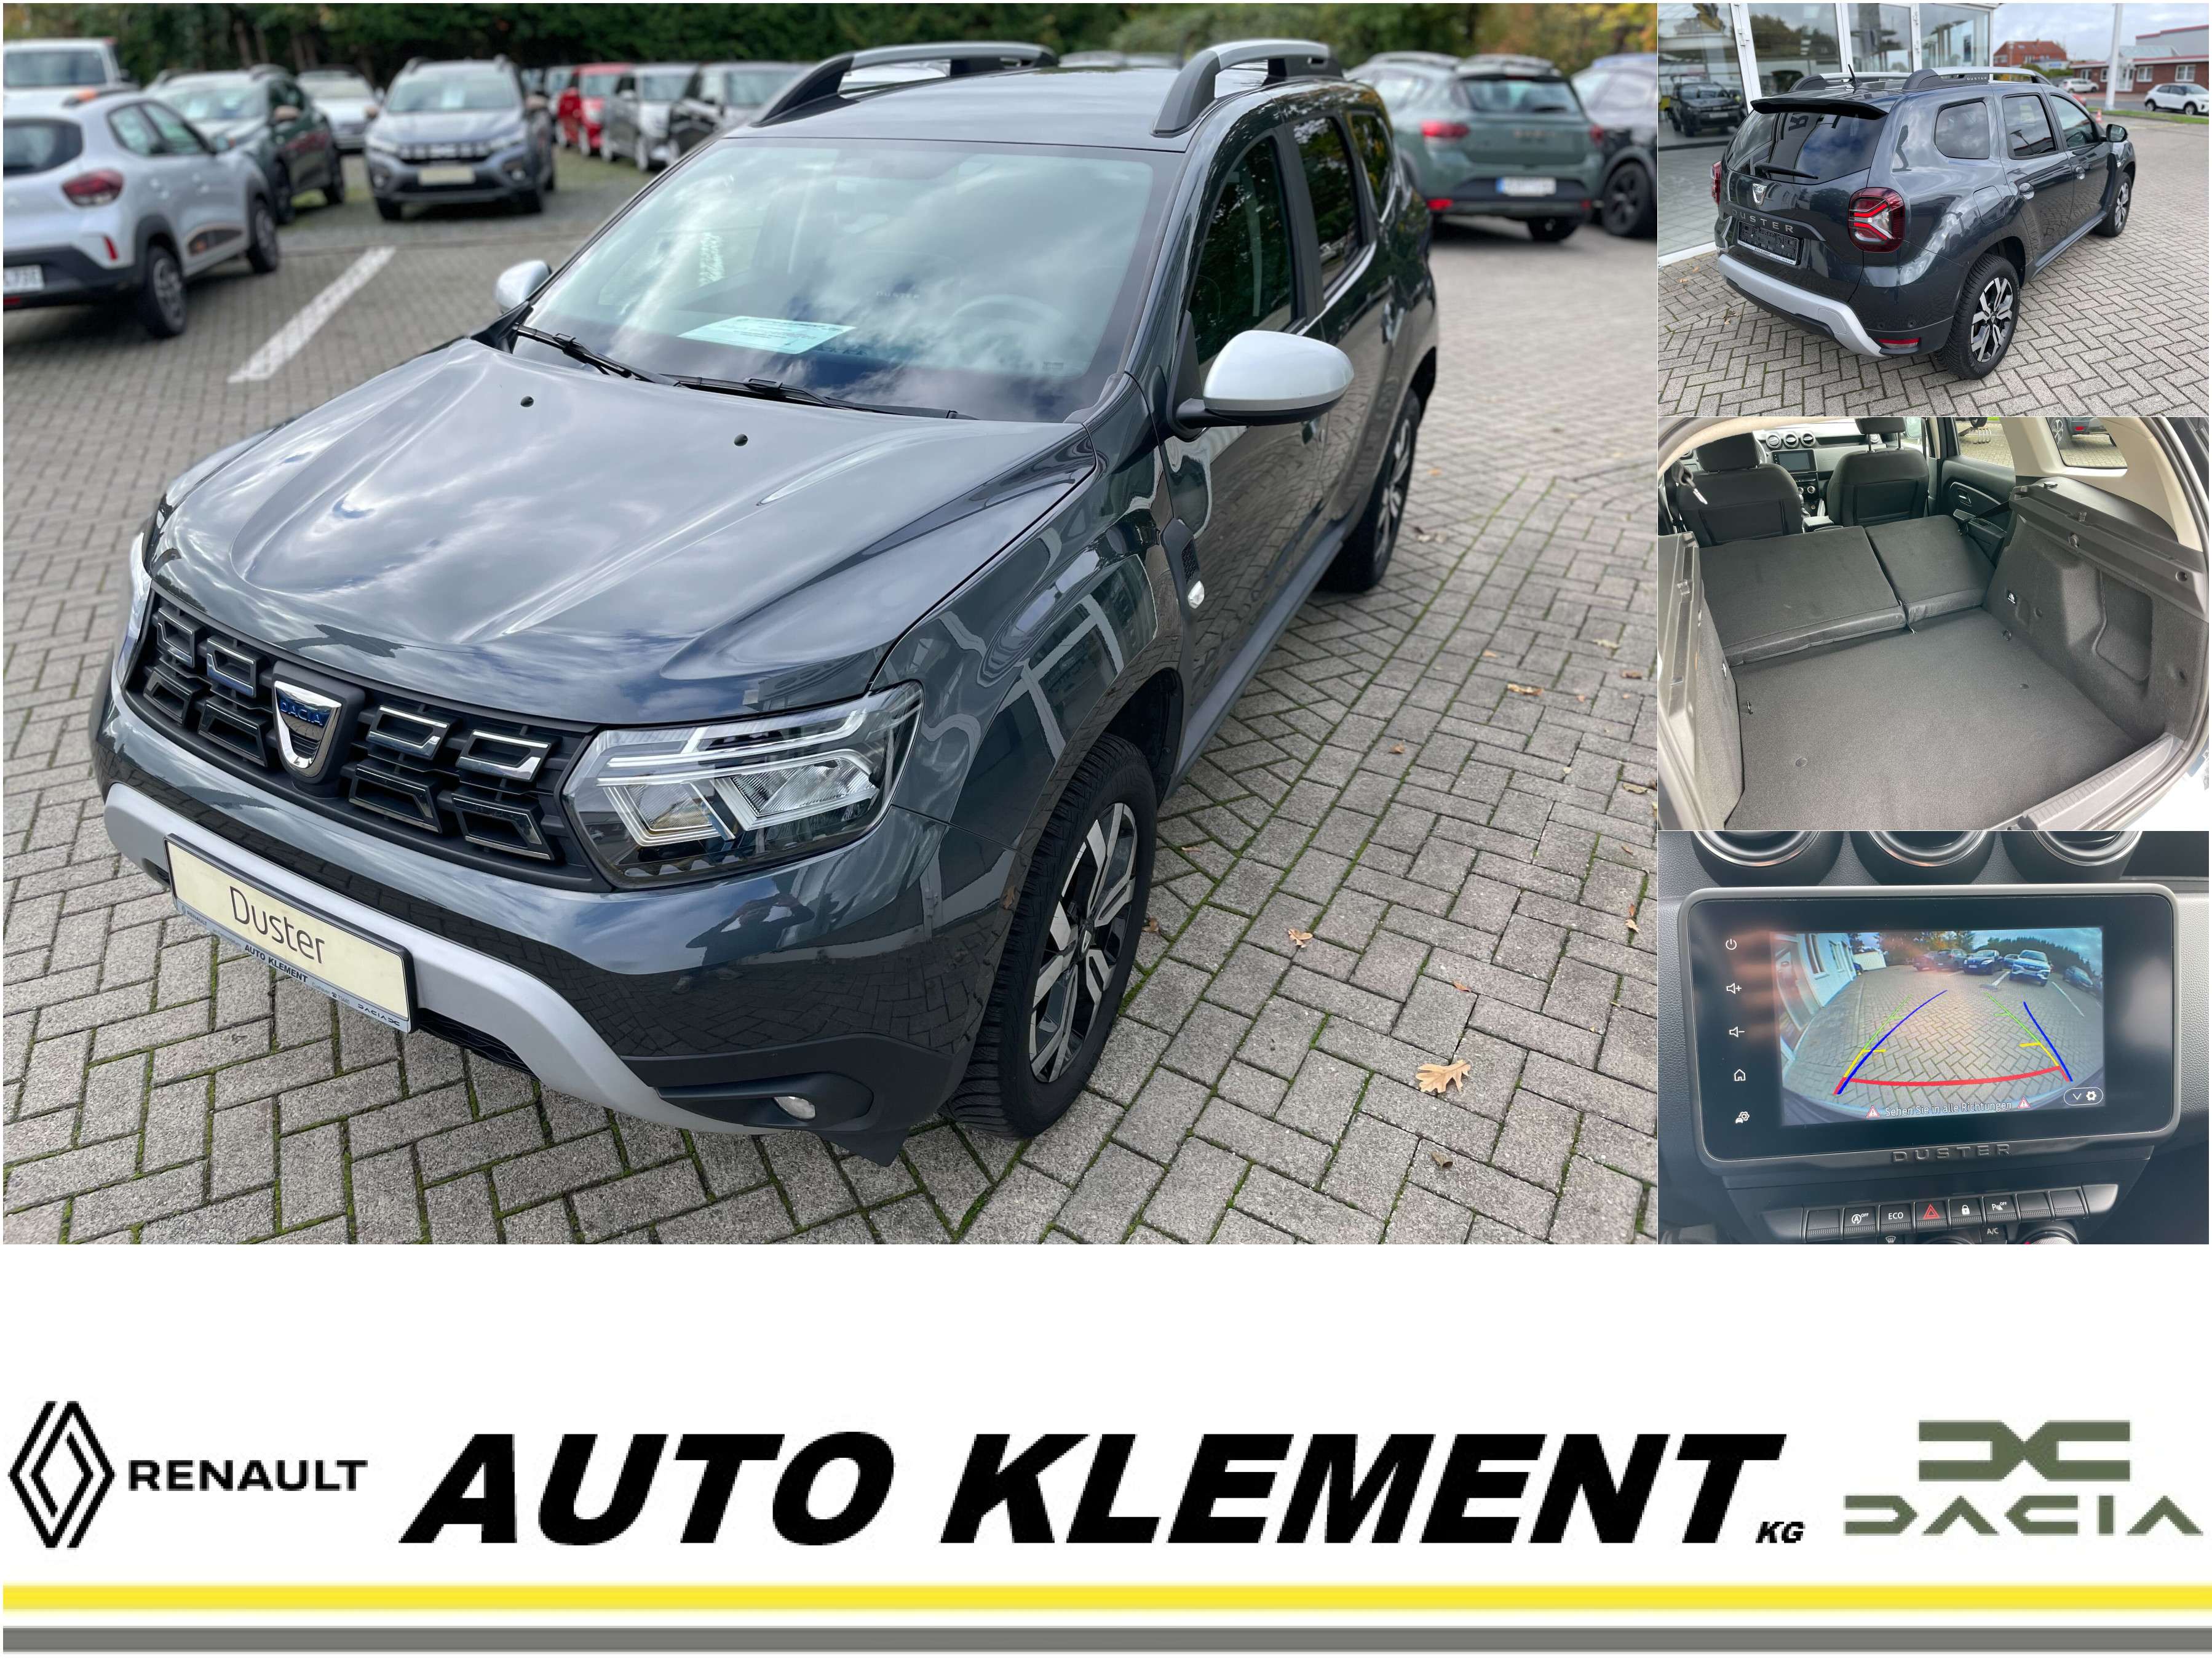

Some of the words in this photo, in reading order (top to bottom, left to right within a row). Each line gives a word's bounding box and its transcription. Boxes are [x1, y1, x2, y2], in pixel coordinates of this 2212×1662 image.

[1731, 209, 1794, 233] DUSTER
[280, 701, 323, 726] DACIA
[230, 886, 325, 964] Duster
[245, 944, 266, 961] AUTO
[268, 956, 308, 983] KLEMENT
[1885, 1107, 1914, 1117] Sehen
[1916, 1105, 1929, 1115] Sie
[1932, 1104, 1940, 1114] in
[1943, 1103, 1959, 1113] alle
[1962, 1101, 2012, 1113] Richtungen
[1892, 1143, 2010, 1162] DUSTER
[1888, 1212, 1904, 1220] ECO
